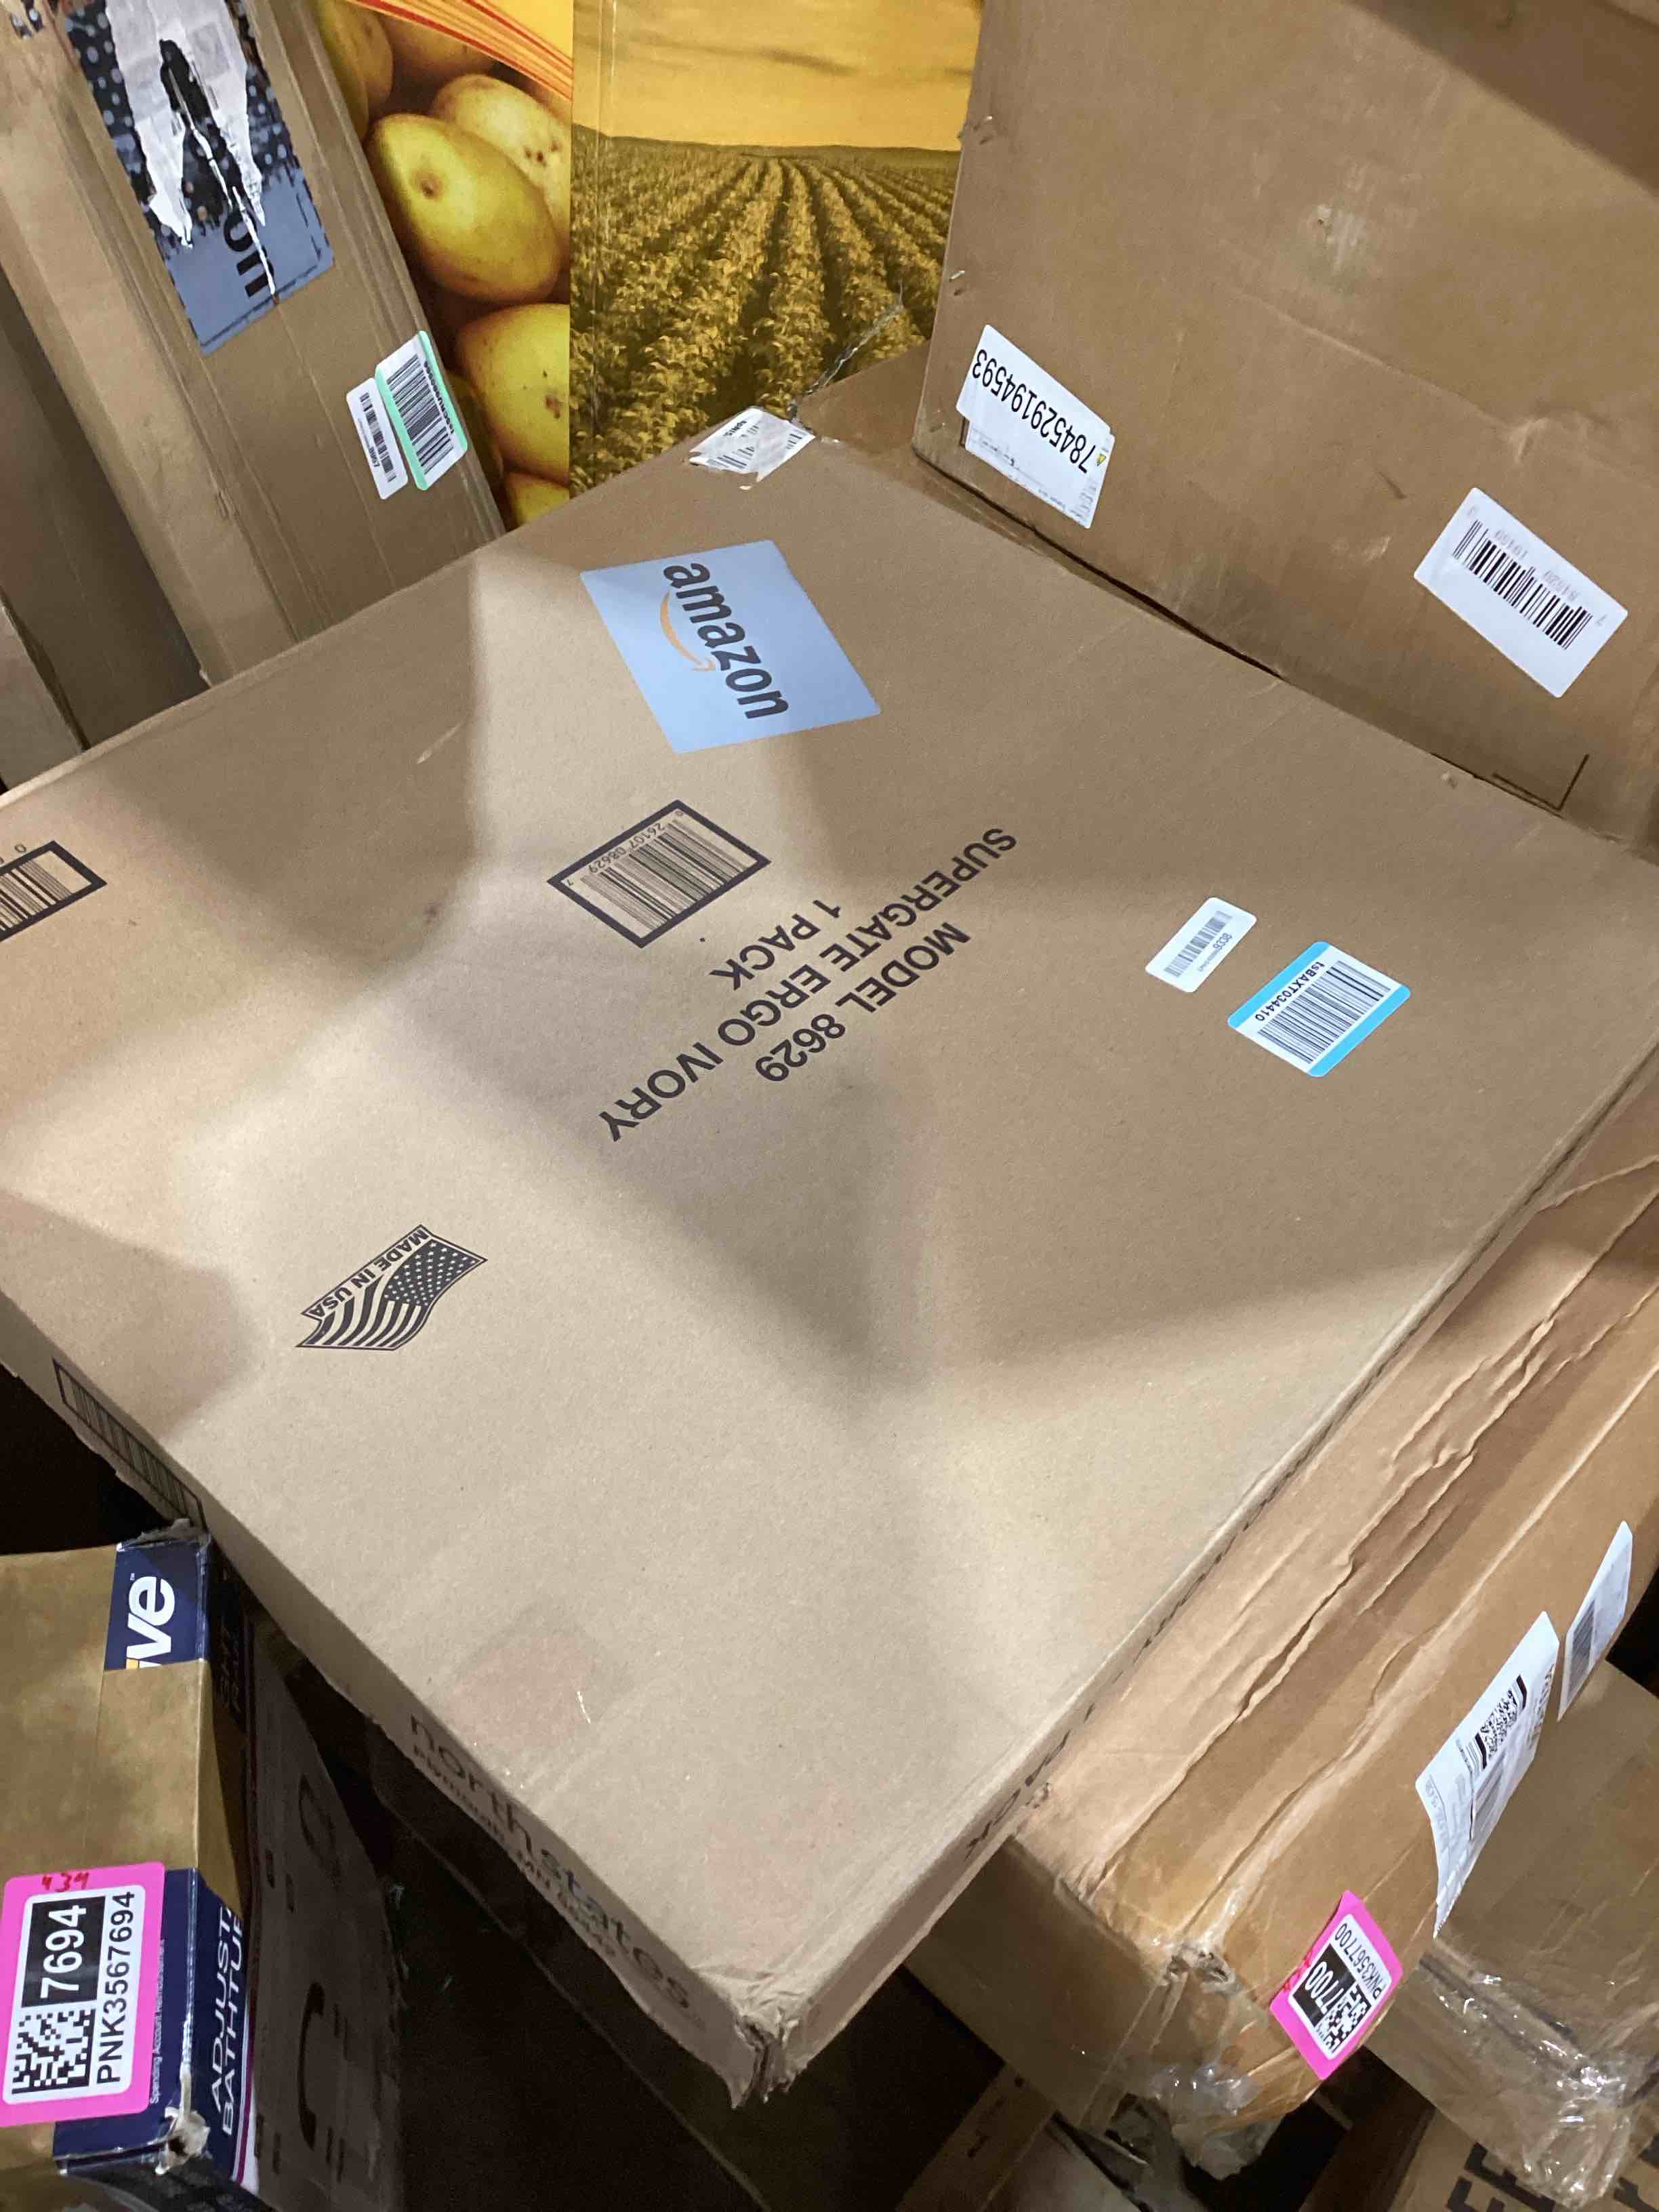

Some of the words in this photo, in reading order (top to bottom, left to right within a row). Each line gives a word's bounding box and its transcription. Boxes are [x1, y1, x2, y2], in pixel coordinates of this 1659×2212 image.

[972, 349, 1097, 474] 784529194593
[662, 562, 790, 720] amazon
[813, 899, 841, 918] 1
[819, 827, 1017, 972] SUPERGATE
[709, 914, 821, 991] PACK
[835, 922, 970, 1013] MODEL
[1255, 961, 1325, 1021] tsBAXT034410
[718, 964, 831, 1046] ERGO
[755, 1014, 846, 1082] 8629
[598, 1042, 724, 1142] IVORY
[350, 1268, 376, 1288] IN
[373, 1229, 430, 1271] MADE
[308, 1287, 353, 1317] USA
[40, 1904, 87, 1999] 7694
[96, 1891, 136, 2085] PNK3567694
[1305, 1961, 1344, 2014] 7700
[1334, 1923, 1387, 2000] PNK3567700
[211, 1906, 232, 2113] ADJUST
